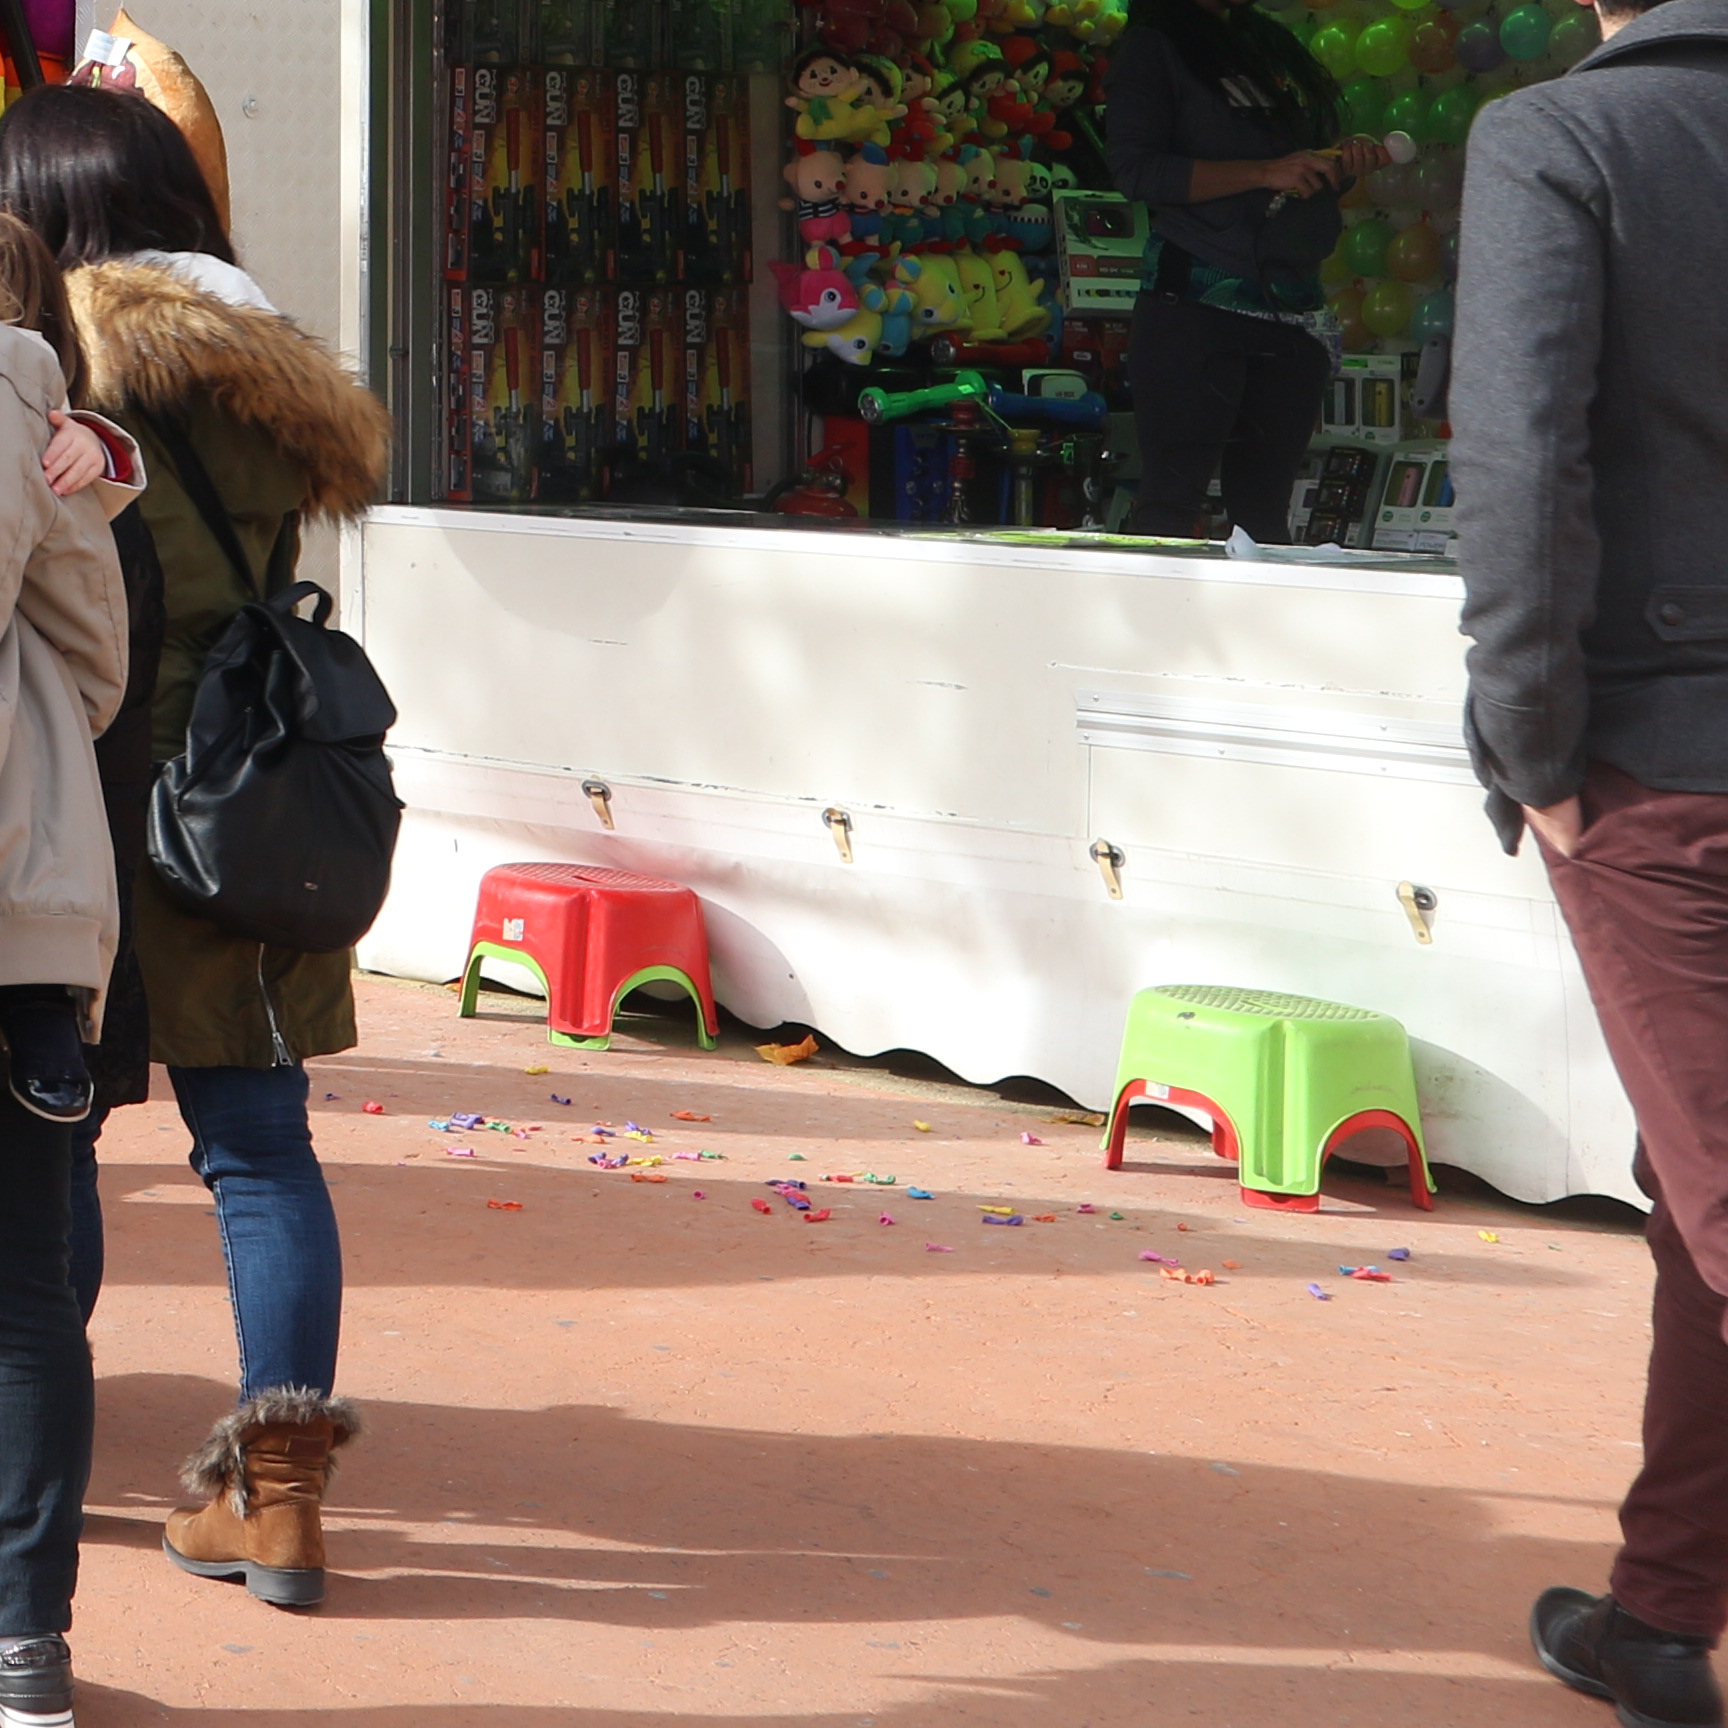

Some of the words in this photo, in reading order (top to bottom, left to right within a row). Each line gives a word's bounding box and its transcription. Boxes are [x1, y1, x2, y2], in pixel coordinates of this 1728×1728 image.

[474, 68, 492, 124] GUN
[546, 71, 562, 126] GUN
[617, 73, 633, 128] GUN
[686, 75, 702, 129] GUN
[472, 288, 489, 344] GUN
[544, 290, 561, 345] GUN
[618, 290, 634, 346] GUN
[686, 290, 701, 343] GUN
